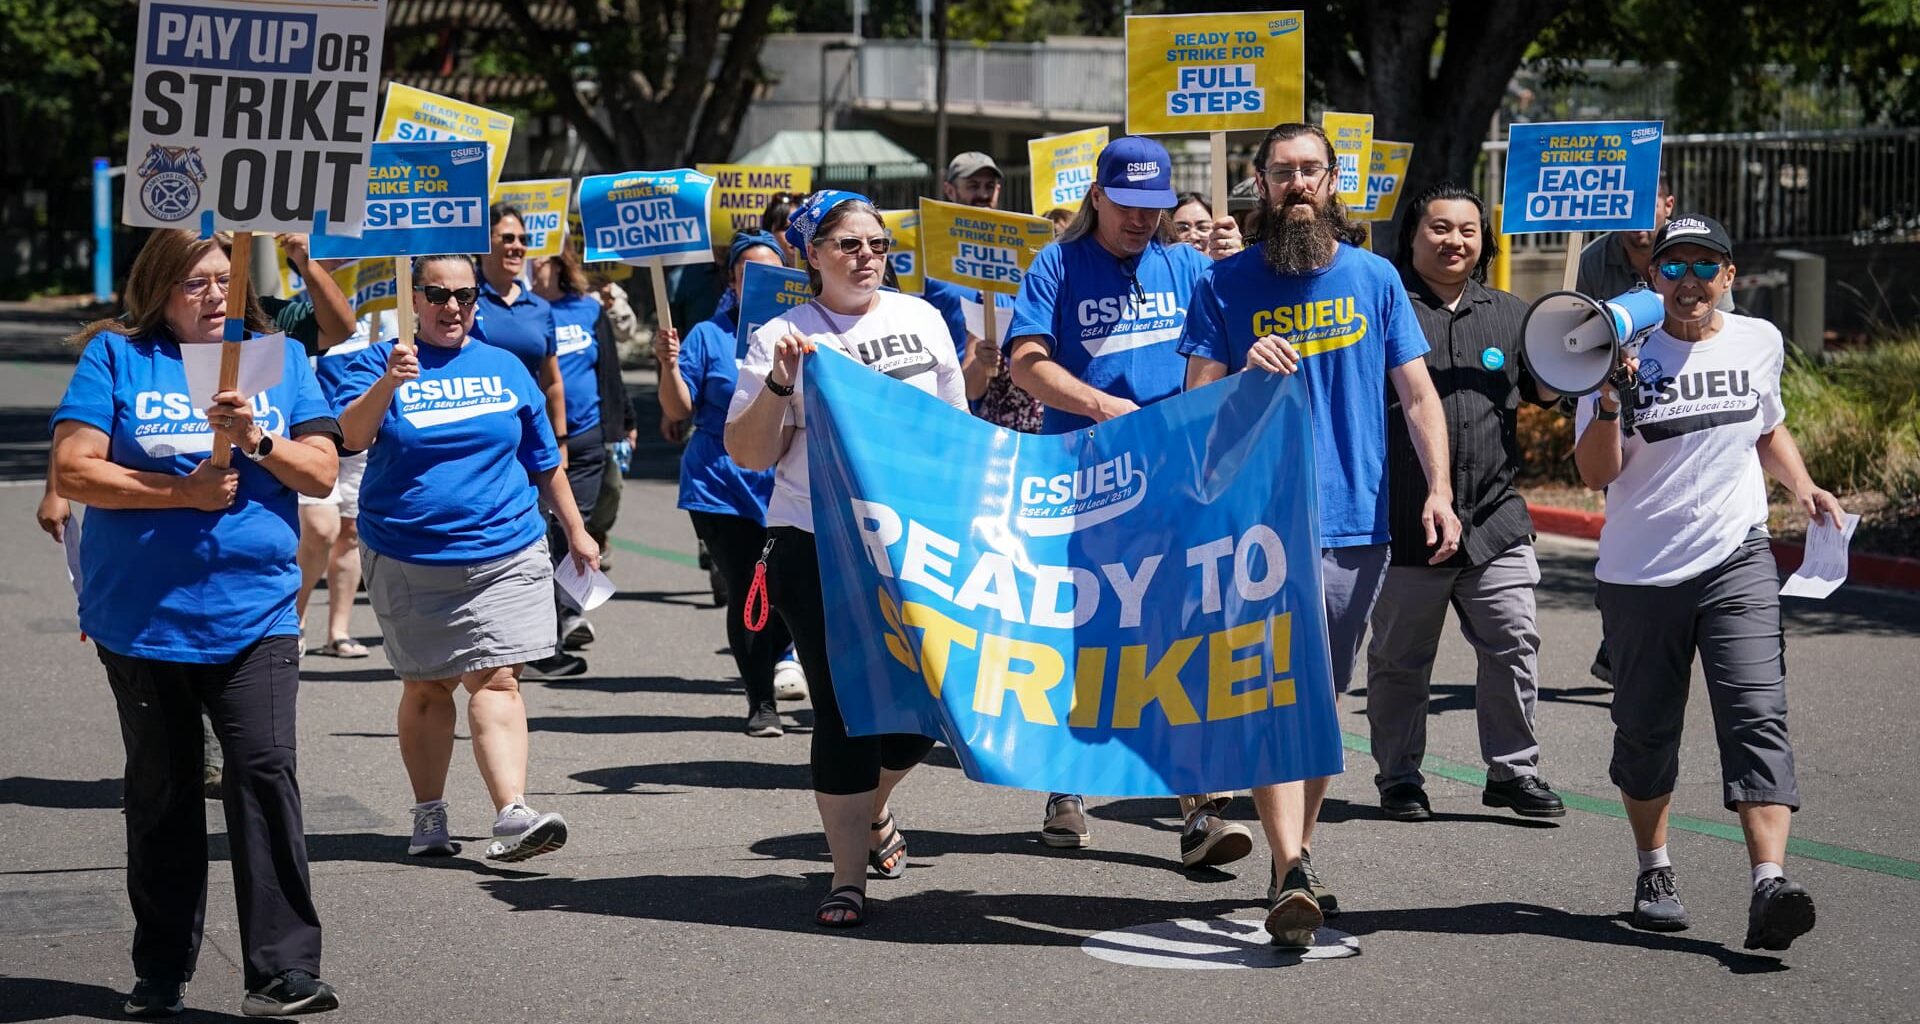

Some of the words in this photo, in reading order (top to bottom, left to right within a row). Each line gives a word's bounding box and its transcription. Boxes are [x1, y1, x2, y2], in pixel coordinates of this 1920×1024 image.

[1268, 17, 1297, 29] CSUEU
[157, 12, 241, 60] PAY
[249, 19, 309, 63] UP
[317, 33, 370, 72] OR
[1175, 32, 1229, 46] READY
[1234, 31, 1257, 44] TO
[1167, 47, 1227, 62] STRIKE
[1232, 46, 1264, 59] FOR
[1181, 67, 1251, 89] FULL
[142, 70, 368, 142] STRIKE
[1171, 90, 1261, 114] STEPS
[414, 111, 456, 129] STRIKE
[460, 123, 483, 137] FOR
[421, 102, 460, 119] READY
[464, 113, 480, 126] TO
[1550, 136, 1599, 148] READY
[1602, 135, 1621, 147] TO
[1631, 127, 1657, 138] CSUEU
[450, 147, 481, 159] CSUEU
[1338, 155, 1356, 171] FULL
[1541, 150, 1593, 163] STRIKE
[1597, 149, 1627, 161] FOR
[368, 165, 412, 179] EADY
[416, 165, 440, 178] TO
[1057, 168, 1091, 185] FULL
[1127, 161, 1157, 172] CSUEU
[218, 148, 363, 222] OUT
[368, 181, 410, 195] RIKE
[414, 180, 448, 193] FOR
[717, 172, 742, 188] WE
[748, 172, 792, 189] MAKE
[1339, 175, 1358, 190] TEPS
[1542, 168, 1620, 192] EACH
[608, 187, 653, 201] STRIKE
[655, 184, 679, 195] FOR
[366, 200, 477, 227] SPECT
[621, 201, 672, 224] OUR
[1529, 193, 1628, 218] OTHER
[600, 220, 694, 249] DIGNITY
[954, 217, 996, 232] READY
[1000, 224, 1018, 235] TO
[949, 228, 995, 243] STRIKE
[998, 235, 1025, 247] FOR
[960, 242, 1015, 266] FULL
[954, 258, 1022, 283] STEPS
[784, 280, 813, 295] REA
[1078, 291, 1177, 326] CSUEU
[1253, 296, 1355, 337] CSUEU
[1080, 326, 1103, 338] CSEA
[1111, 323, 1130, 333] SEIU
[1132, 323, 1150, 331] Local
[1152, 319, 1174, 329] 2579
[1329, 325, 1352, 337] 2579
[857, 333, 923, 365] UEU
[400, 376, 503, 404] CSUEU
[1635, 369, 1749, 410] CSUEU
[135, 390, 270, 421] CSU
[402, 402, 426, 412] CSEA
[433, 401, 456, 409] SEIU
[456, 398, 478, 408] Local
[1668, 404, 1693, 416] SEIU
[1695, 401, 1720, 412] Local
[135, 423, 169, 436] CSEA
[180, 422, 210, 433] SEIU
[1020, 451, 1133, 505] CSUEU
[1020, 506, 1051, 517] CSEA
[1060, 502, 1087, 516] SEIU
[1087, 497, 1110, 510] Local
[1111, 486, 1132, 502] 2579
[851, 497, 1163, 629] READY
[1186, 524, 1287, 614] TO
[878, 585, 1296, 729] STRIKE!
